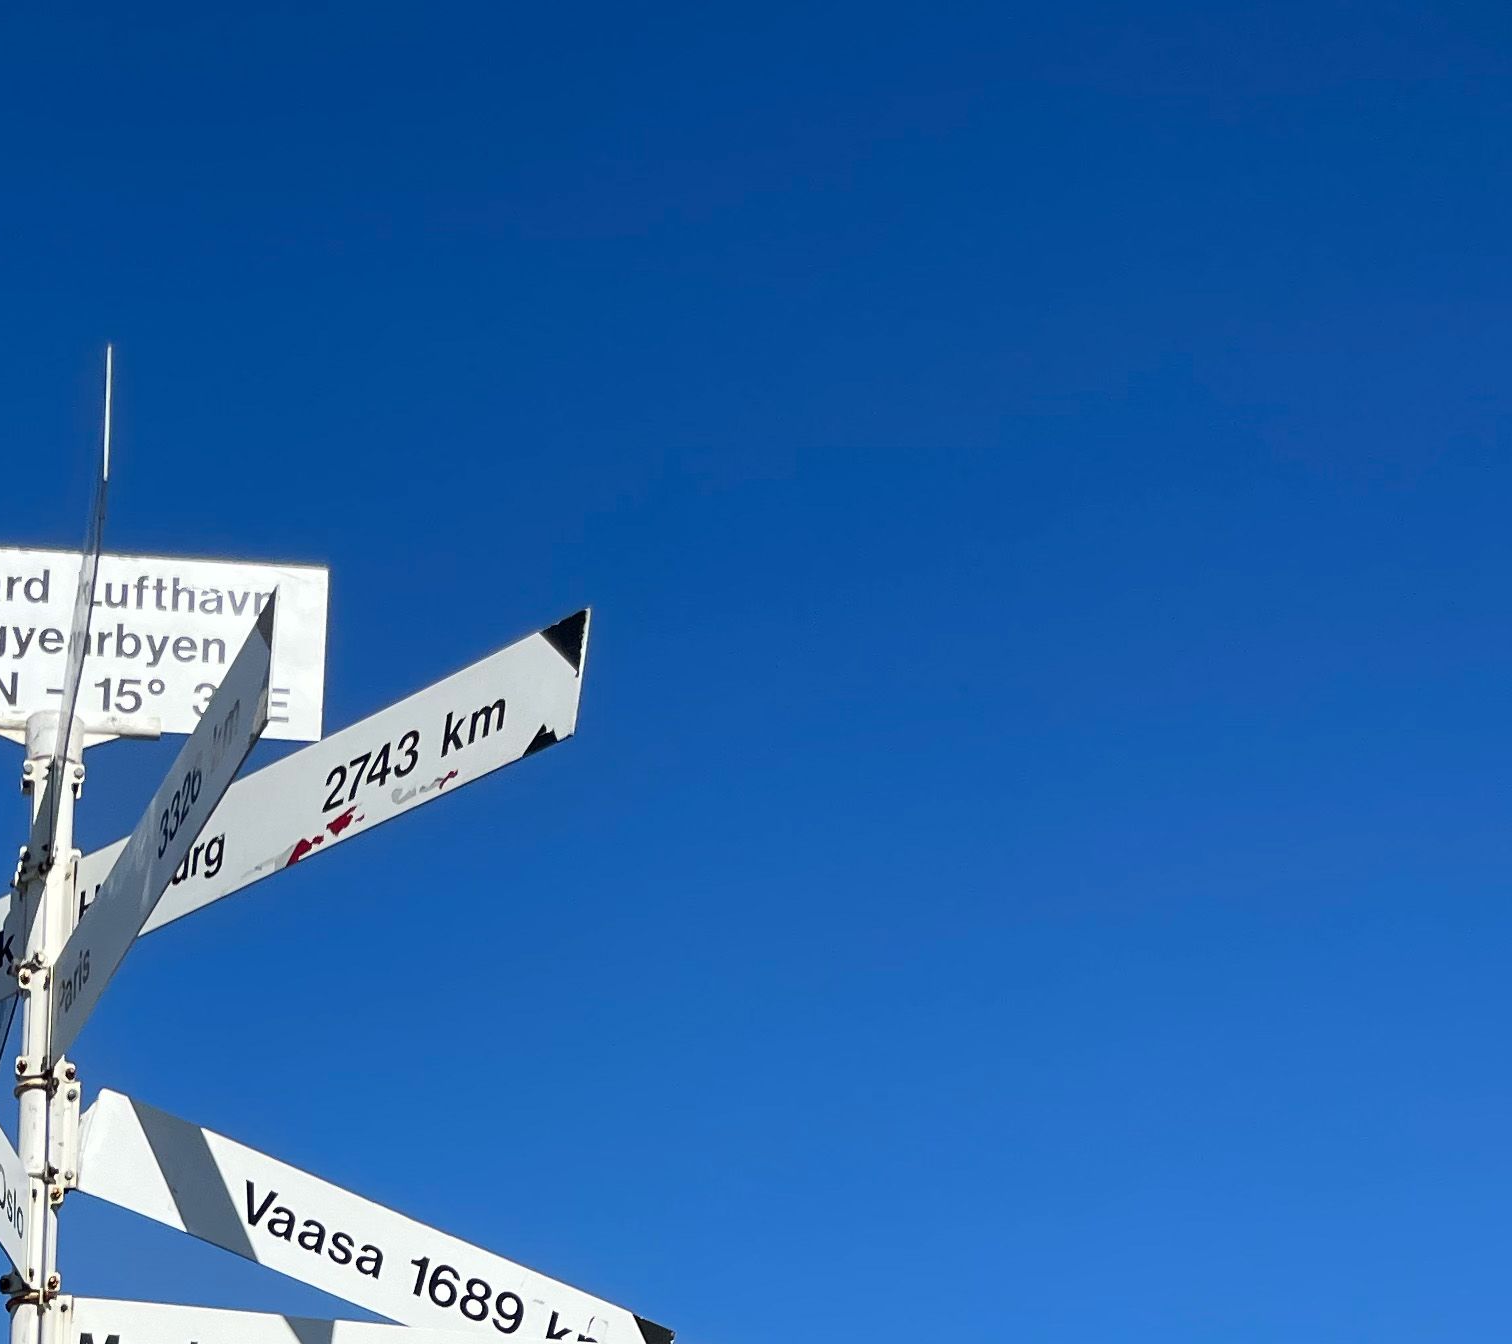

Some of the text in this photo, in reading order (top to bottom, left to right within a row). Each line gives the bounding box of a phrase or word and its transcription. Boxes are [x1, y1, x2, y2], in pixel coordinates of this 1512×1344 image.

[94, 677, 166, 714] 15°
[321, 729, 421, 813] 2743
[439, 696, 507, 759] km
[244, 1179, 384, 1280] Vaasa
[409, 1256, 526, 1336] 1689
